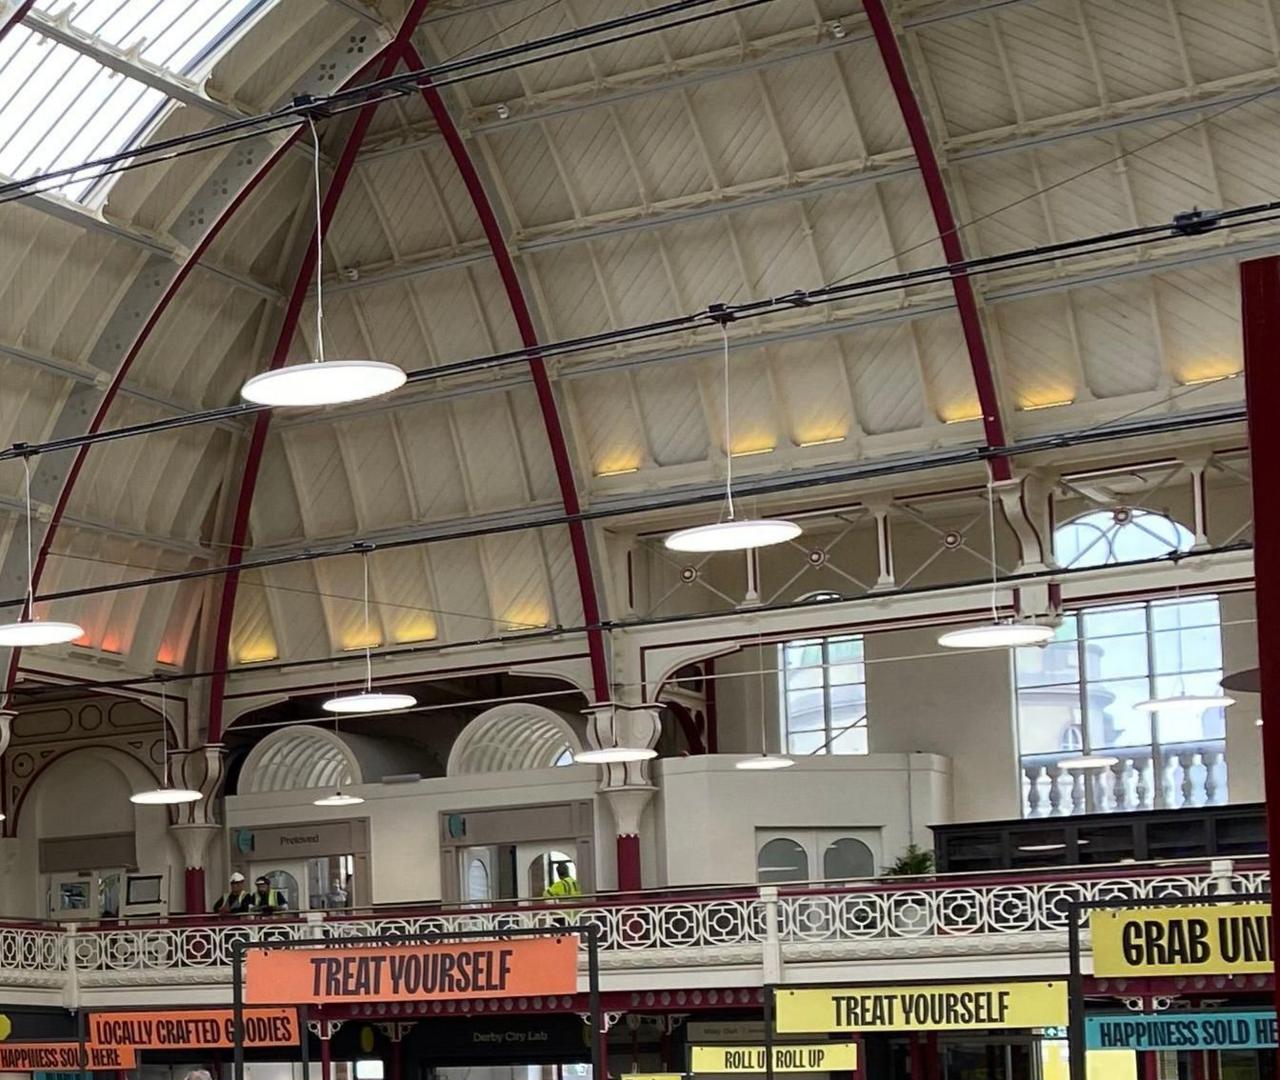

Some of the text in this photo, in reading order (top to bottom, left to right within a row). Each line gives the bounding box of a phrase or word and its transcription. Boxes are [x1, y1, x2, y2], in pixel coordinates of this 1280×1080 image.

[1122, 919, 1211, 966] GRAB
[310, 950, 513, 996] TREAT YOURSELF
[831, 991, 1010, 1026] TREAT YOURSELF
[96, 1016, 291, 1045] LOCALLY CRAFTED GODIES
[1100, 1021, 1199, 1047] HAPPINESS
[1201, 1019, 1251, 1046] SOLD
[0, 1047, 59, 1068] HAPPINESS
[91, 1047, 121, 1067] HERE
[724, 1049, 825, 1069] ROLL U ROLL UP
